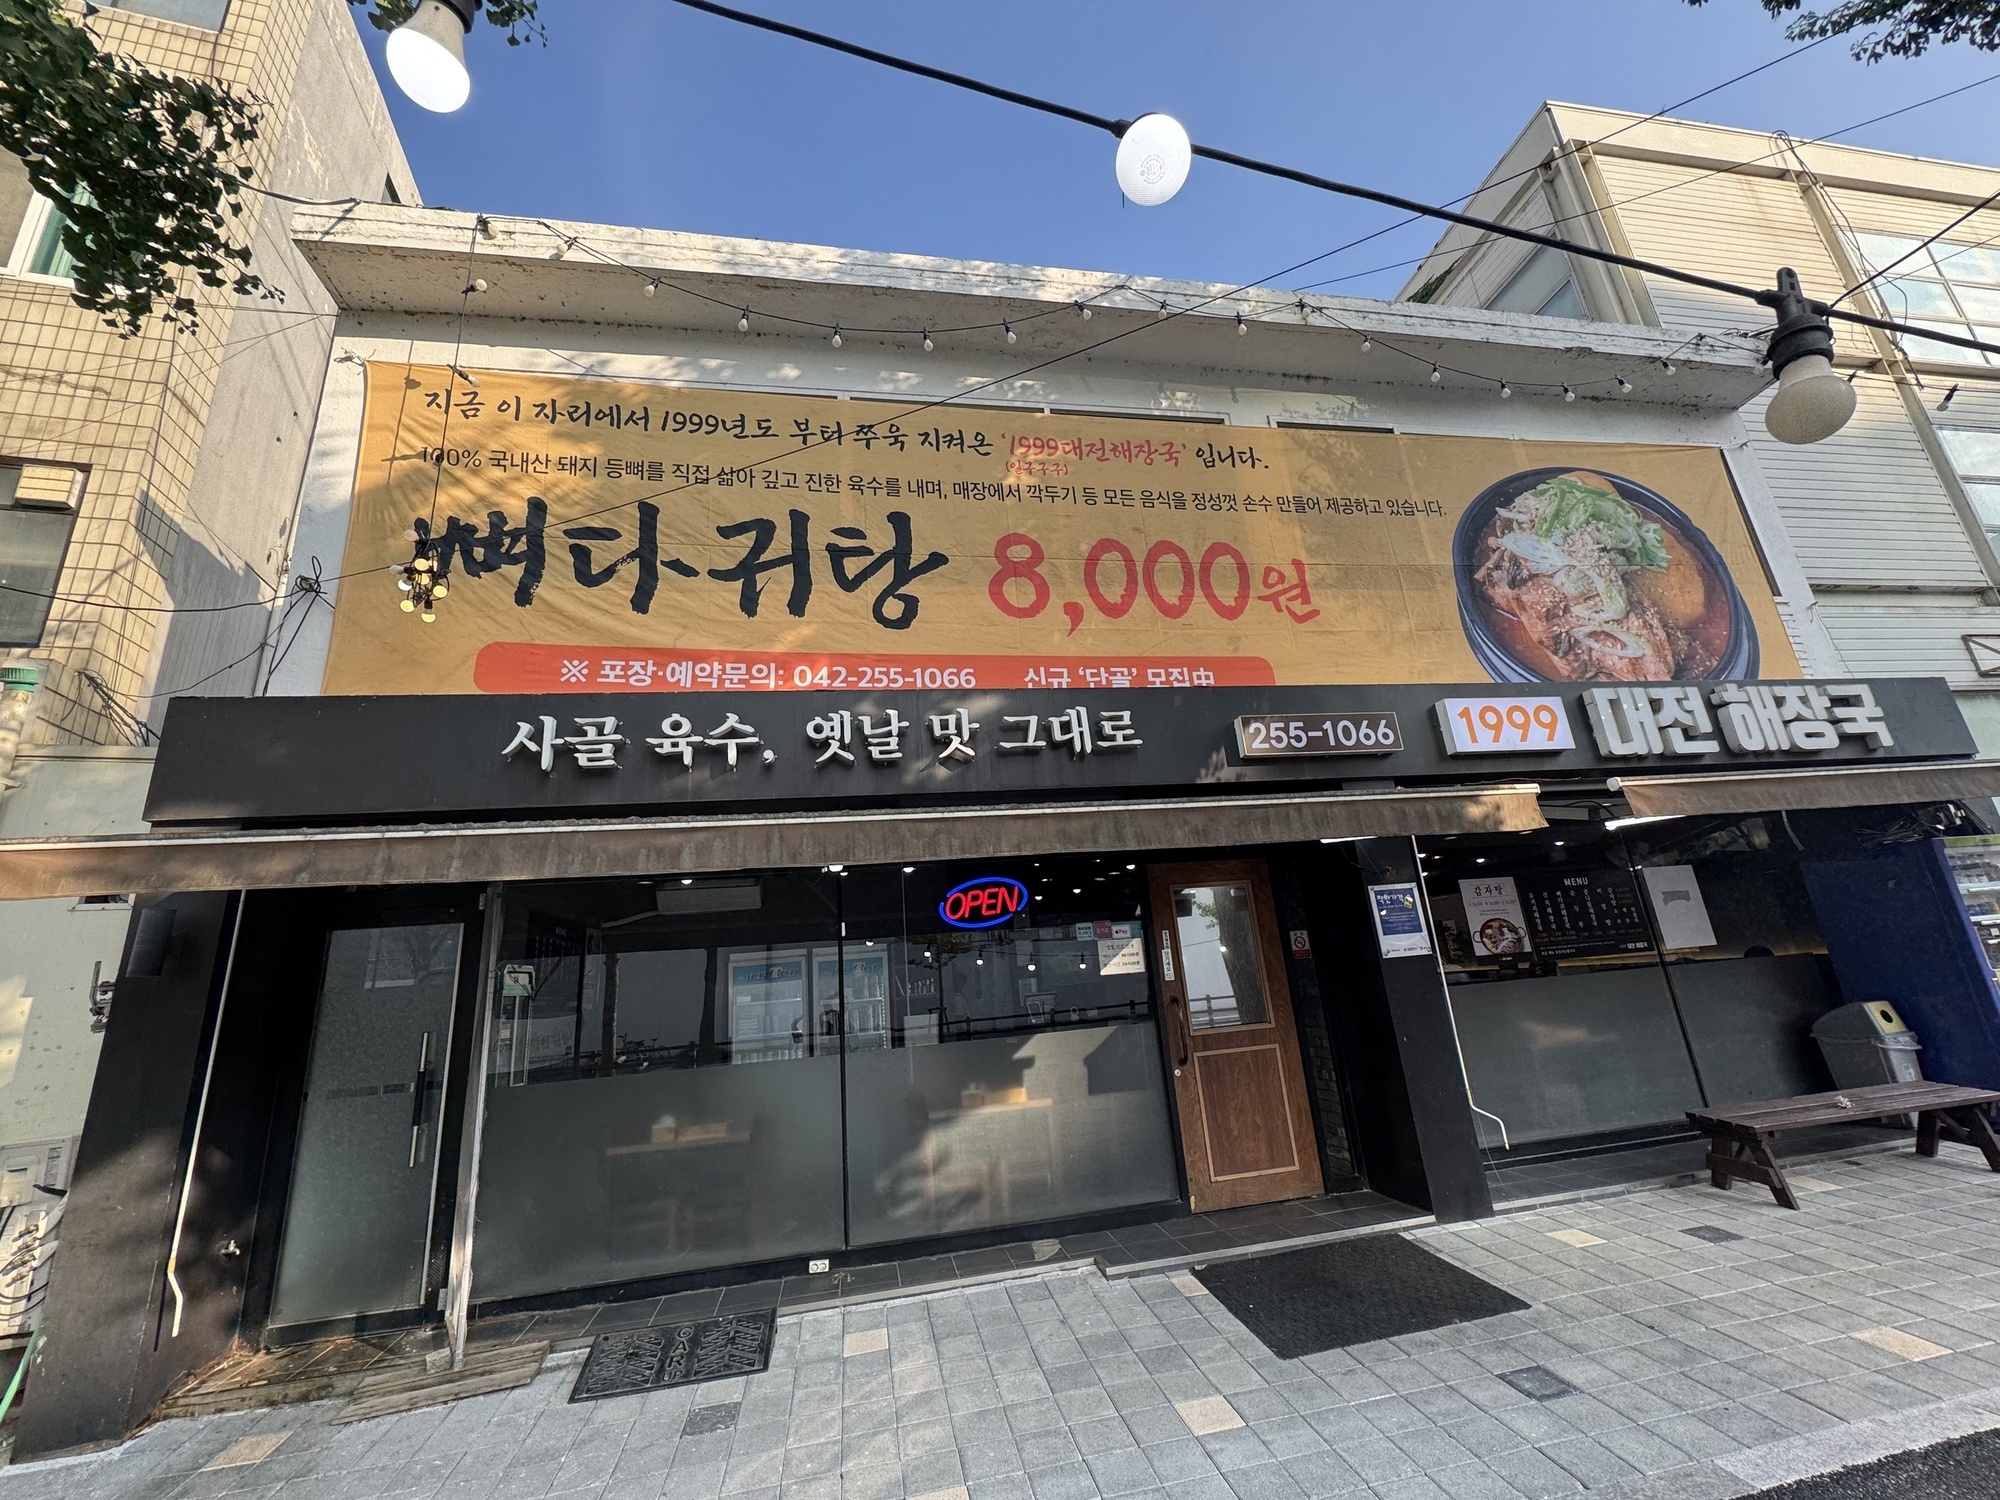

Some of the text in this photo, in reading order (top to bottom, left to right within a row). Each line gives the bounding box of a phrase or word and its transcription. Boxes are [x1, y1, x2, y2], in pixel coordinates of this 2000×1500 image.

[424, 387, 486, 420] 지금
[497, 396, 521, 421] 이
[533, 398, 650, 432] 자리에서
[661, 411, 780, 440] 1999년도
[789, 418, 843, 446] 부터
[852, 423, 909, 452] 쭈욱
[918, 427, 994, 456] 지켜온
[1196, 443, 1270, 470] 입니다.
[420, 446, 1447, 518] 100% 국내산 돼지 등뼈를 직접 삶아 깊고 진한 육수를 내며, 매장에서 깍두기 등 모든 음식을 정성껏 손수 만들어 제공하고 있습니다.
[1005, 459, 1070, 476] (일구구구)
[414, 496, 1322, 639] 뼈다귀탕 8,000원
[792, 664, 977, 689] 042-255-1066
[1024, 666, 1072, 688] 신규
[1248, 719, 1396, 749] 255-1066
[1457, 684, 1895, 758] 1999 대전 해장국
[501, 706, 1143, 774] 사골 육수, 옛날 맛 그대로
[1473, 885, 1504, 897] 감자탕
[1563, 876, 1589, 887] MENU
[945, 886, 1019, 921] OPEN
